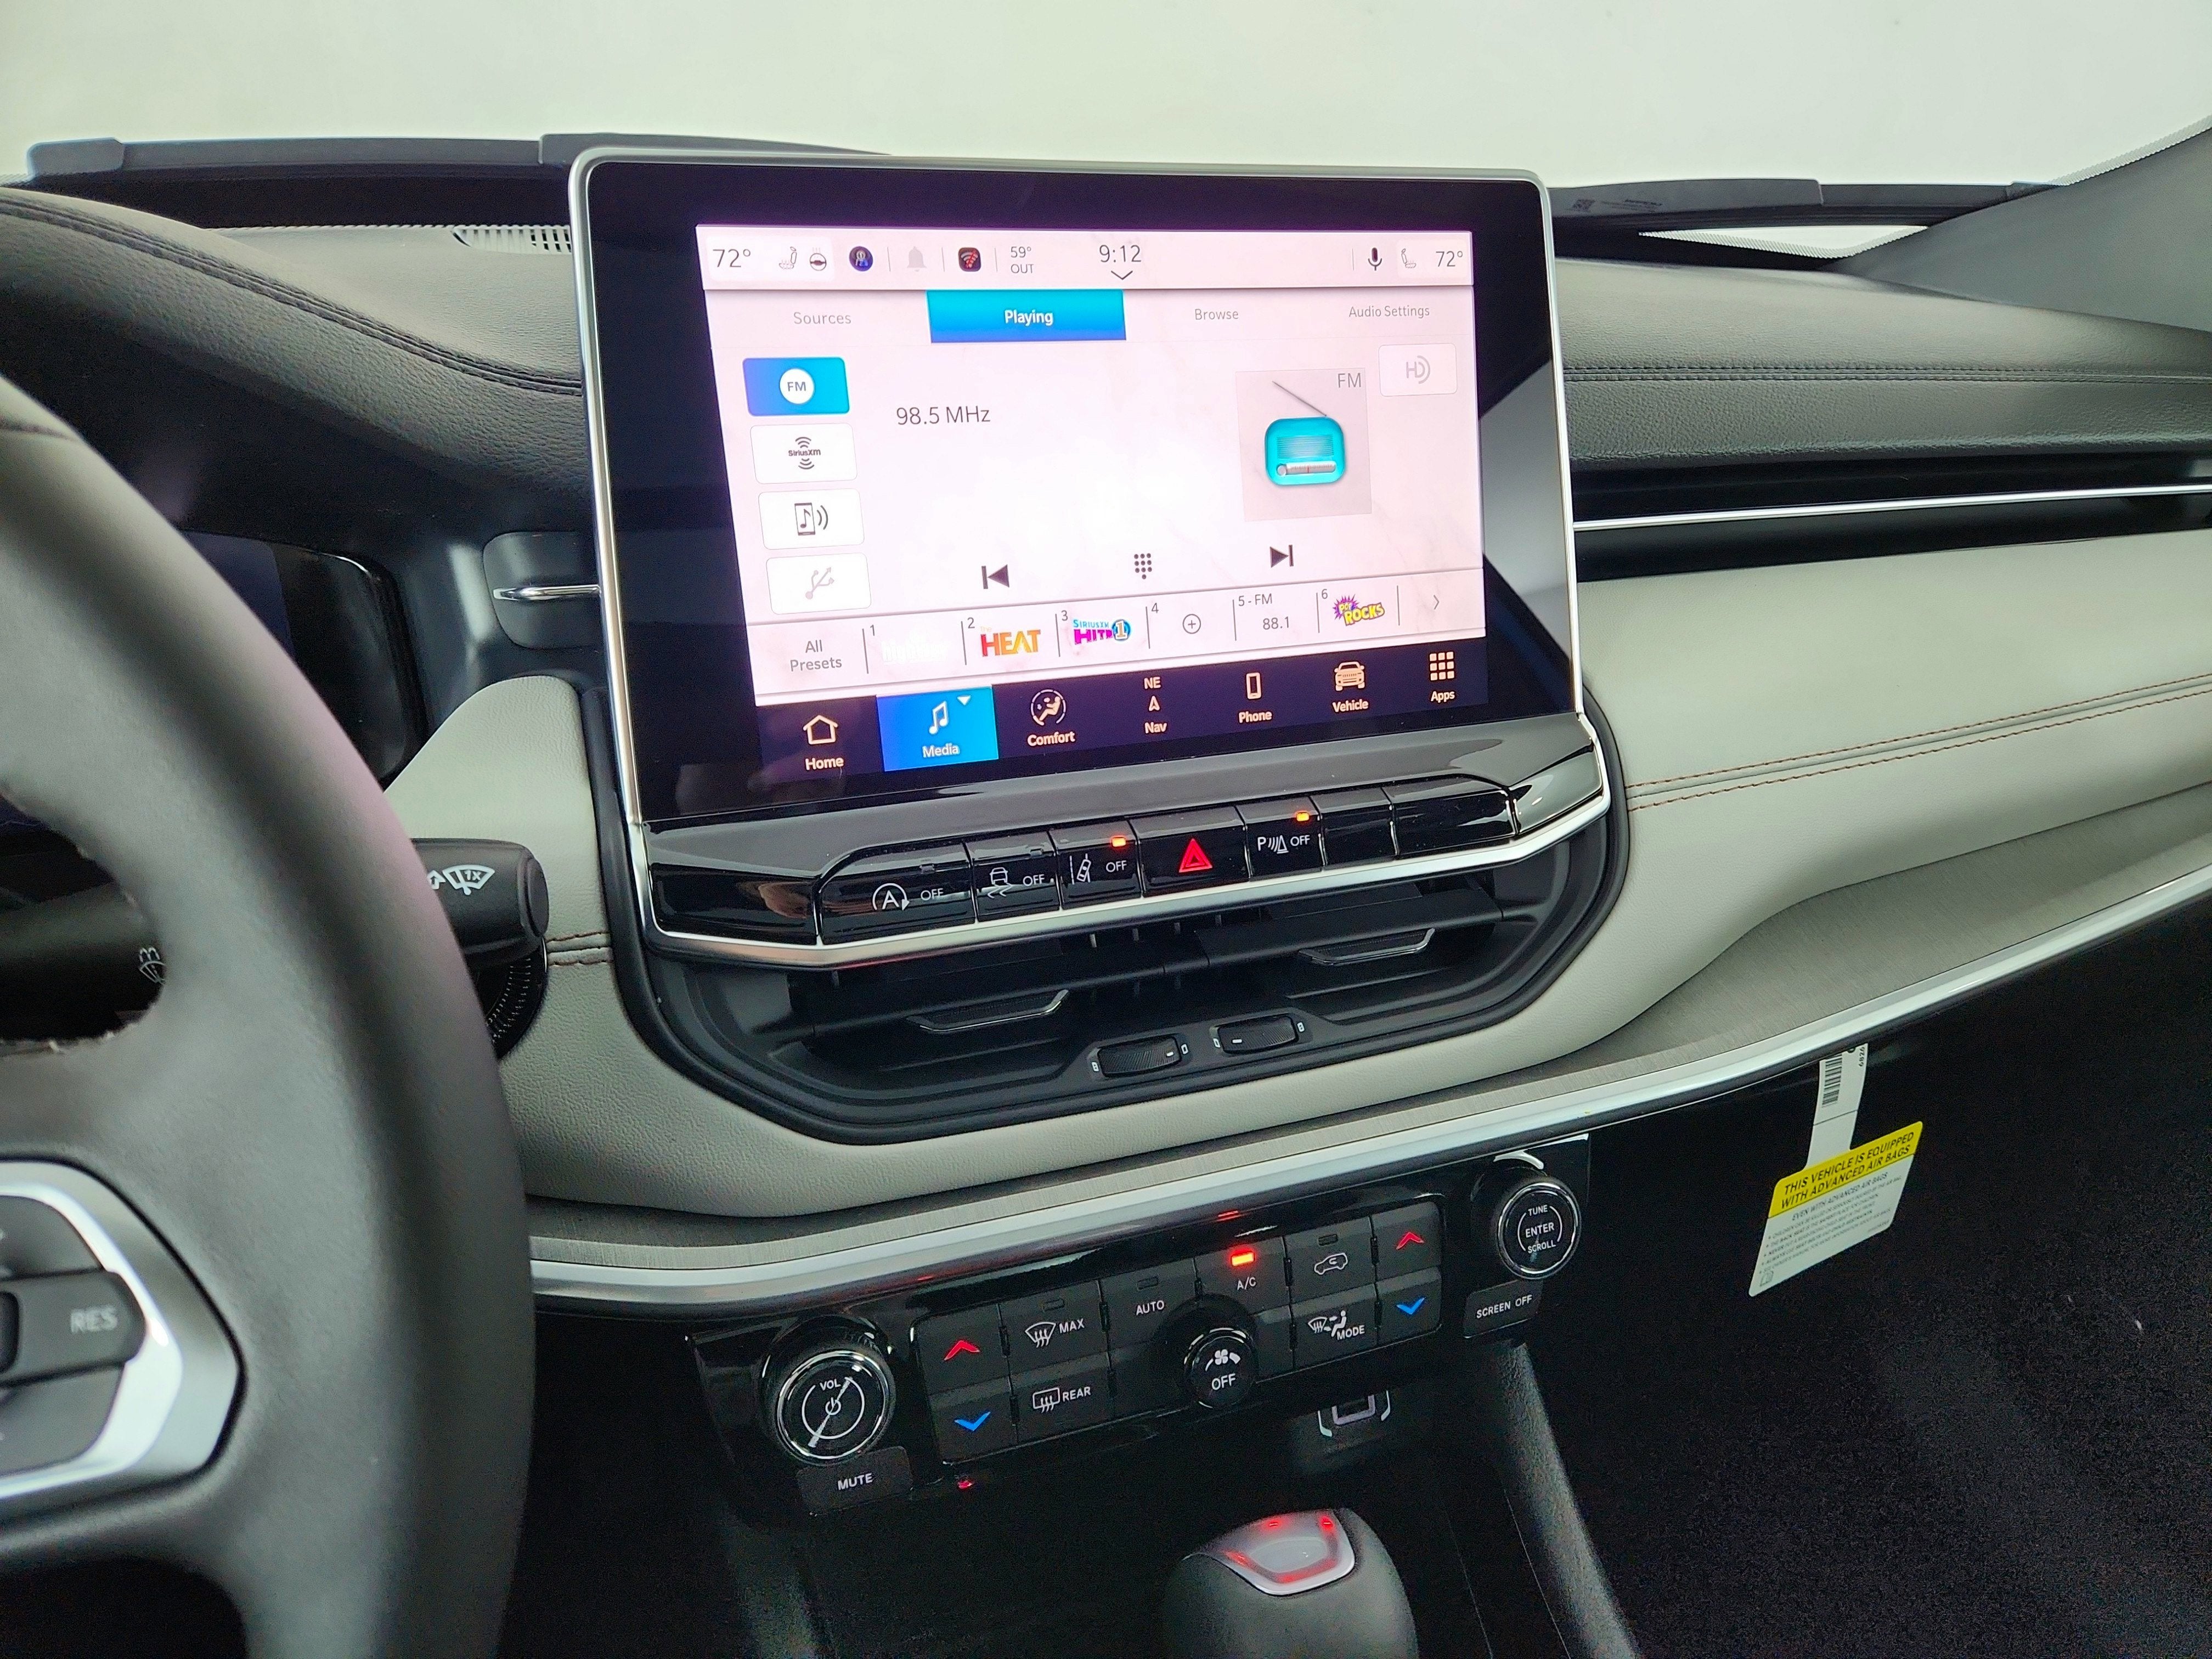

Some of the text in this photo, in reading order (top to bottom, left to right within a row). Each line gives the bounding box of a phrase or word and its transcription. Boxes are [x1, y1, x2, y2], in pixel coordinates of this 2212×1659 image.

[1099, 245, 1142, 263] 9:12
[1011, 263, 1034, 274] OUT
[793, 311, 851, 325] Sources
[1005, 309, 1053, 326] Playing
[1195, 308, 1239, 321] Browse
[1348, 304, 1430, 318] Audio Settings
[787, 381, 807, 392] FM
[1338, 373, 1362, 388] FM
[896, 405, 991, 425] 98.5 MHz
[1238, 595, 1245, 606] 5
[1255, 593, 1273, 605] FM
[1321, 589, 1328, 599] 6
[1151, 602, 1159, 613] 4
[1344, 602, 1385, 626] ROCKS
[1061, 610, 1068, 621] 3
[967, 617, 975, 629] 2
[1262, 616, 1289, 630] 88.1
[870, 625, 876, 636] 1
[805, 640, 823, 653] All
[980, 629, 1041, 657] HEAT
[791, 657, 842, 672] Presets
[1144, 677, 1161, 689] NE
[1431, 690, 1455, 704] Apps
[1332, 698, 1369, 713] Vehicle
[1238, 709, 1272, 724] Phone
[1144, 721, 1167, 734] Nav
[1027, 730, 1075, 747] Comfort
[922, 743, 960, 758] Media
[805, 757, 844, 771] Home
[1290, 834, 1311, 847] OFF
[1106, 860, 1127, 873] OFF
[1023, 873, 1045, 886] OFF
[920, 888, 944, 901] OFF
[1785, 1132, 1914, 1195] THIS VEHICLE IS EQUIPPED
[1781, 1144, 1910, 1210] WITH ADVANCED AIR BAGS
[1528, 1205, 1548, 1216] TUNE
[1525, 1221, 1555, 1238] ENTER
[1527, 1239, 1557, 1254] SCROLL
[1237, 1276, 1256, 1290] A/C
[1136, 1300, 1165, 1316] AUTO
[1476, 1294, 1532, 1319] SCREEN OFF
[70, 1306, 117, 1334] RES
[1059, 1318, 1085, 1334] MAX
[1337, 1324, 1365, 1341] MODE
[820, 1379, 841, 1391] VOL
[1211, 1373, 1237, 1390] OFF
[1062, 1386, 1092, 1403] REAR
[837, 1472, 873, 1491] MUTE
